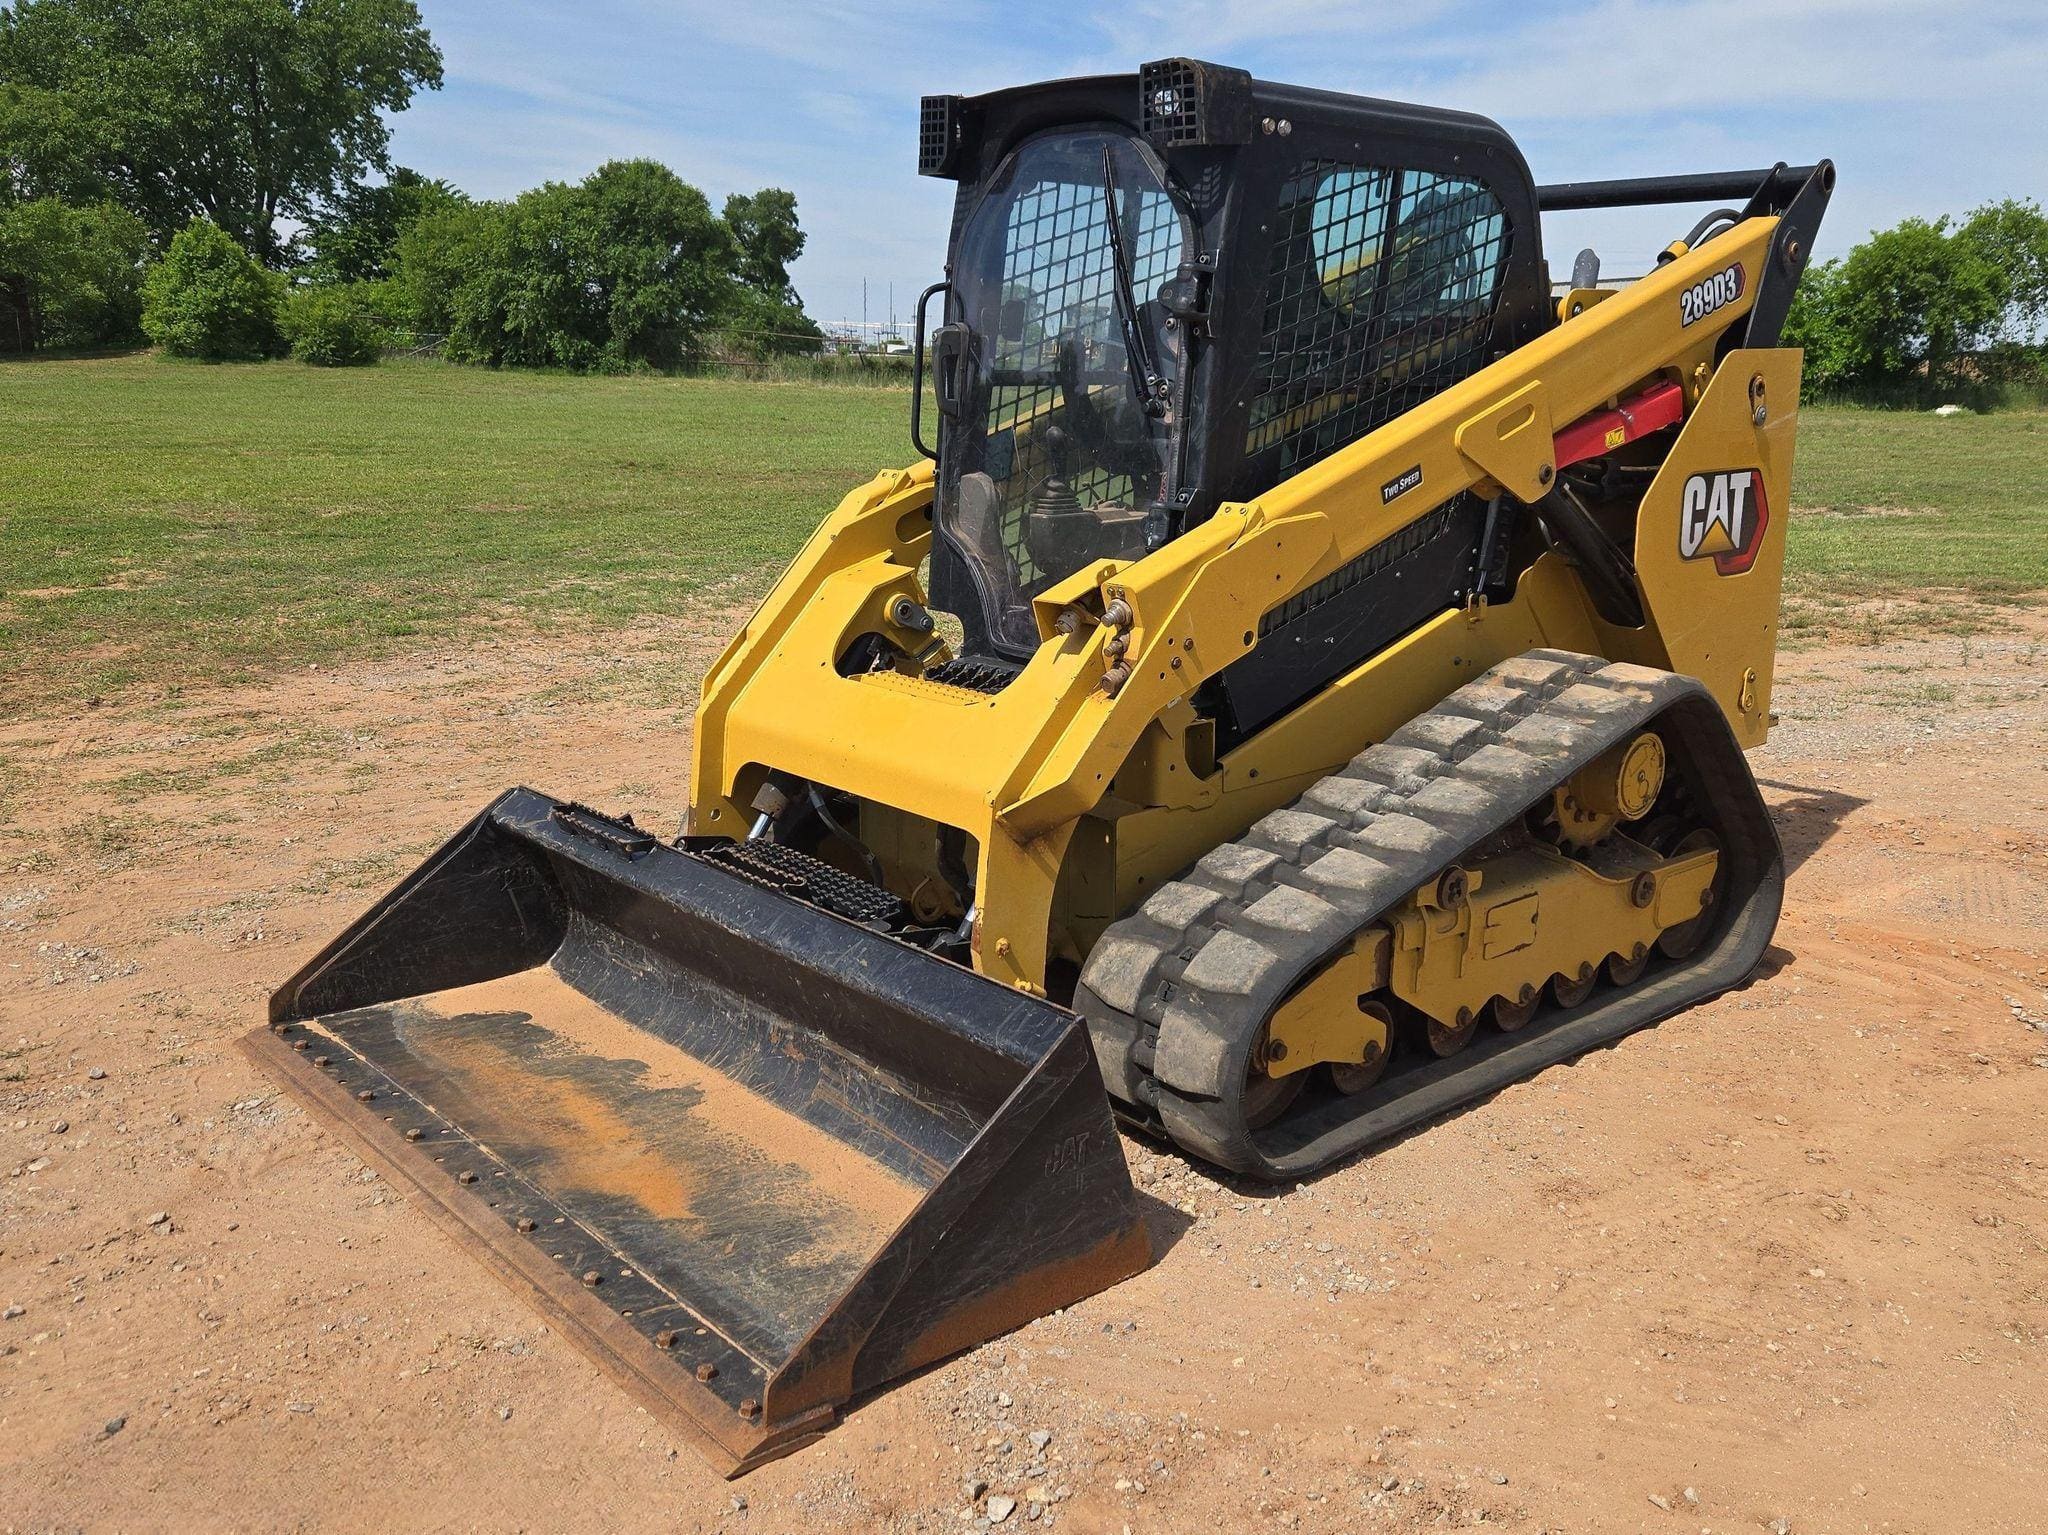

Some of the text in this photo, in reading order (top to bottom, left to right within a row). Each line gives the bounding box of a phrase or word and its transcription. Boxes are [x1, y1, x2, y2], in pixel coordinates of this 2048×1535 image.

[1681, 267, 1737, 327] 289D3
[1383, 471, 1420, 499] TWO SPEED
[1680, 471, 1752, 557] CAT
